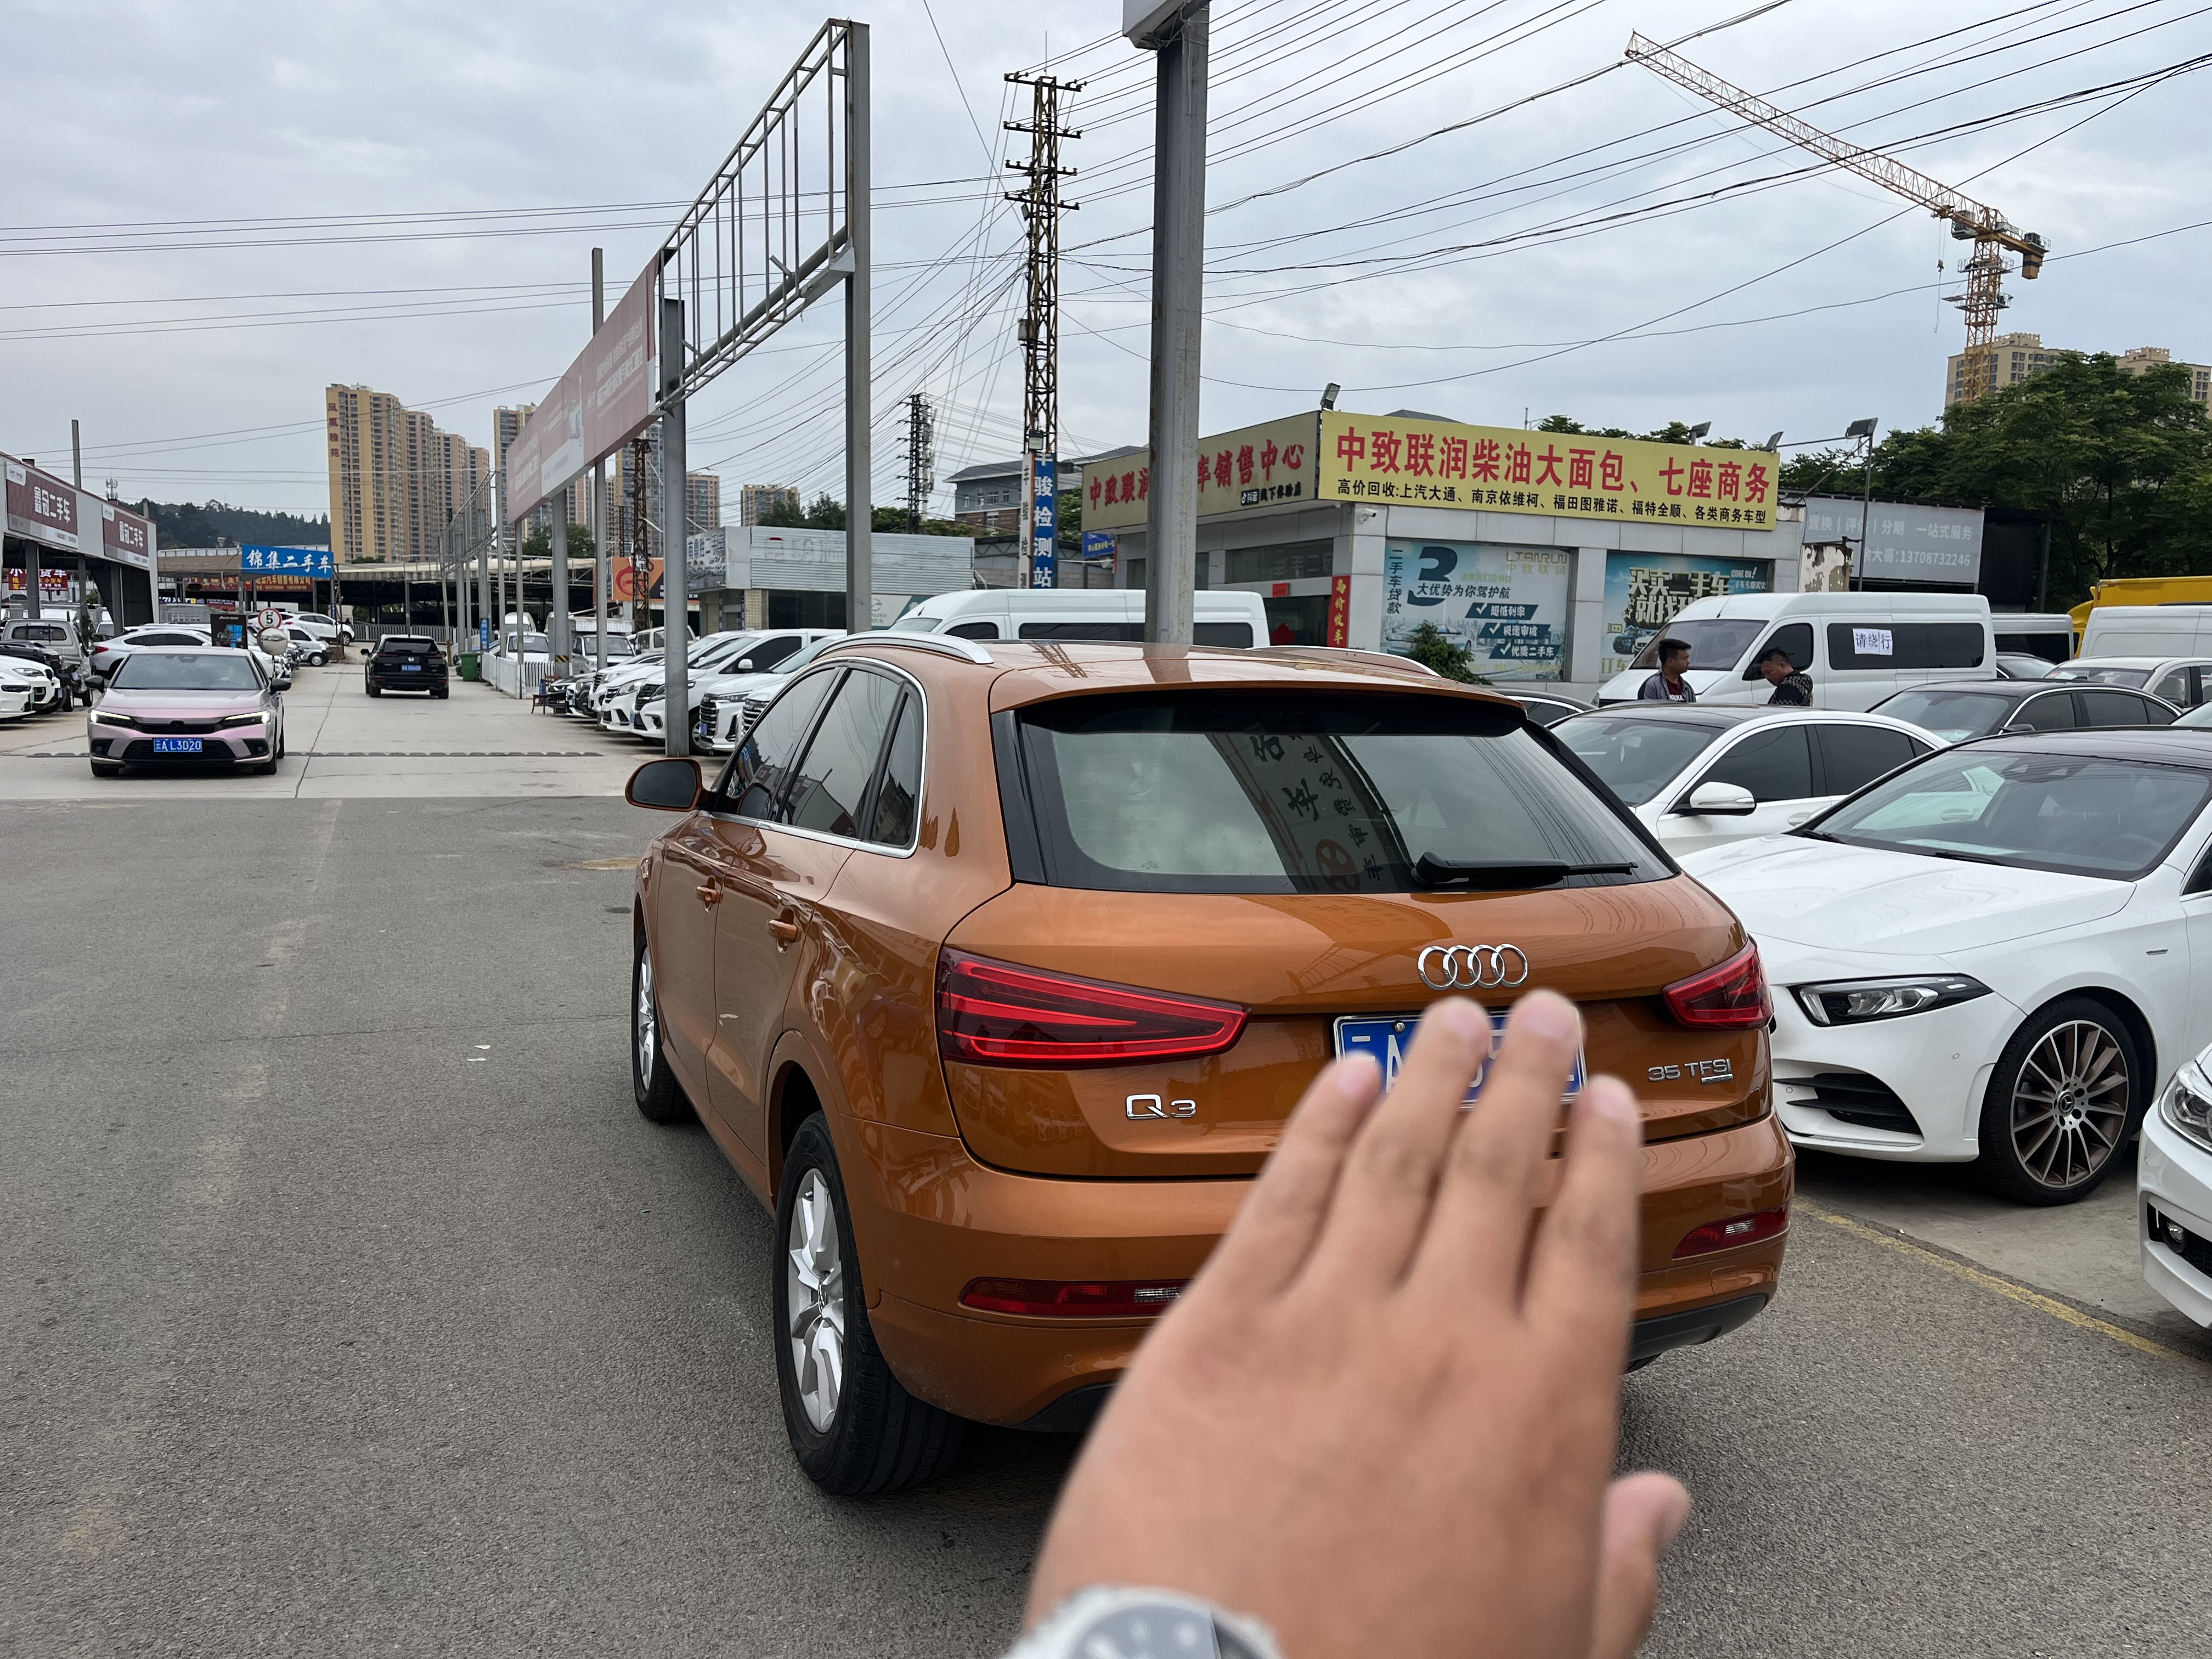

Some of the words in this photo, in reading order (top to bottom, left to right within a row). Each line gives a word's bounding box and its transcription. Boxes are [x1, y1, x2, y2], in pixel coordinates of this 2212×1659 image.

[1916, 523, 1972, 540] 一站式服务
[246, 549, 331, 574] 锦集二手车
[1386, 550, 1403, 614] 二手车贷款
[1417, 583, 1511, 599] 大优势为你驾护航
[1491, 605, 1525, 617] 超低利率
[266, 615, 273, 624] 5
[1855, 633, 1891, 649] 请绕行
[1511, 646, 1554, 657] 优质二手车
[1647, 1065, 1681, 1081] 35
[1684, 1058, 1732, 1077] TFSI
[1126, 1094, 1196, 1120] Q3
